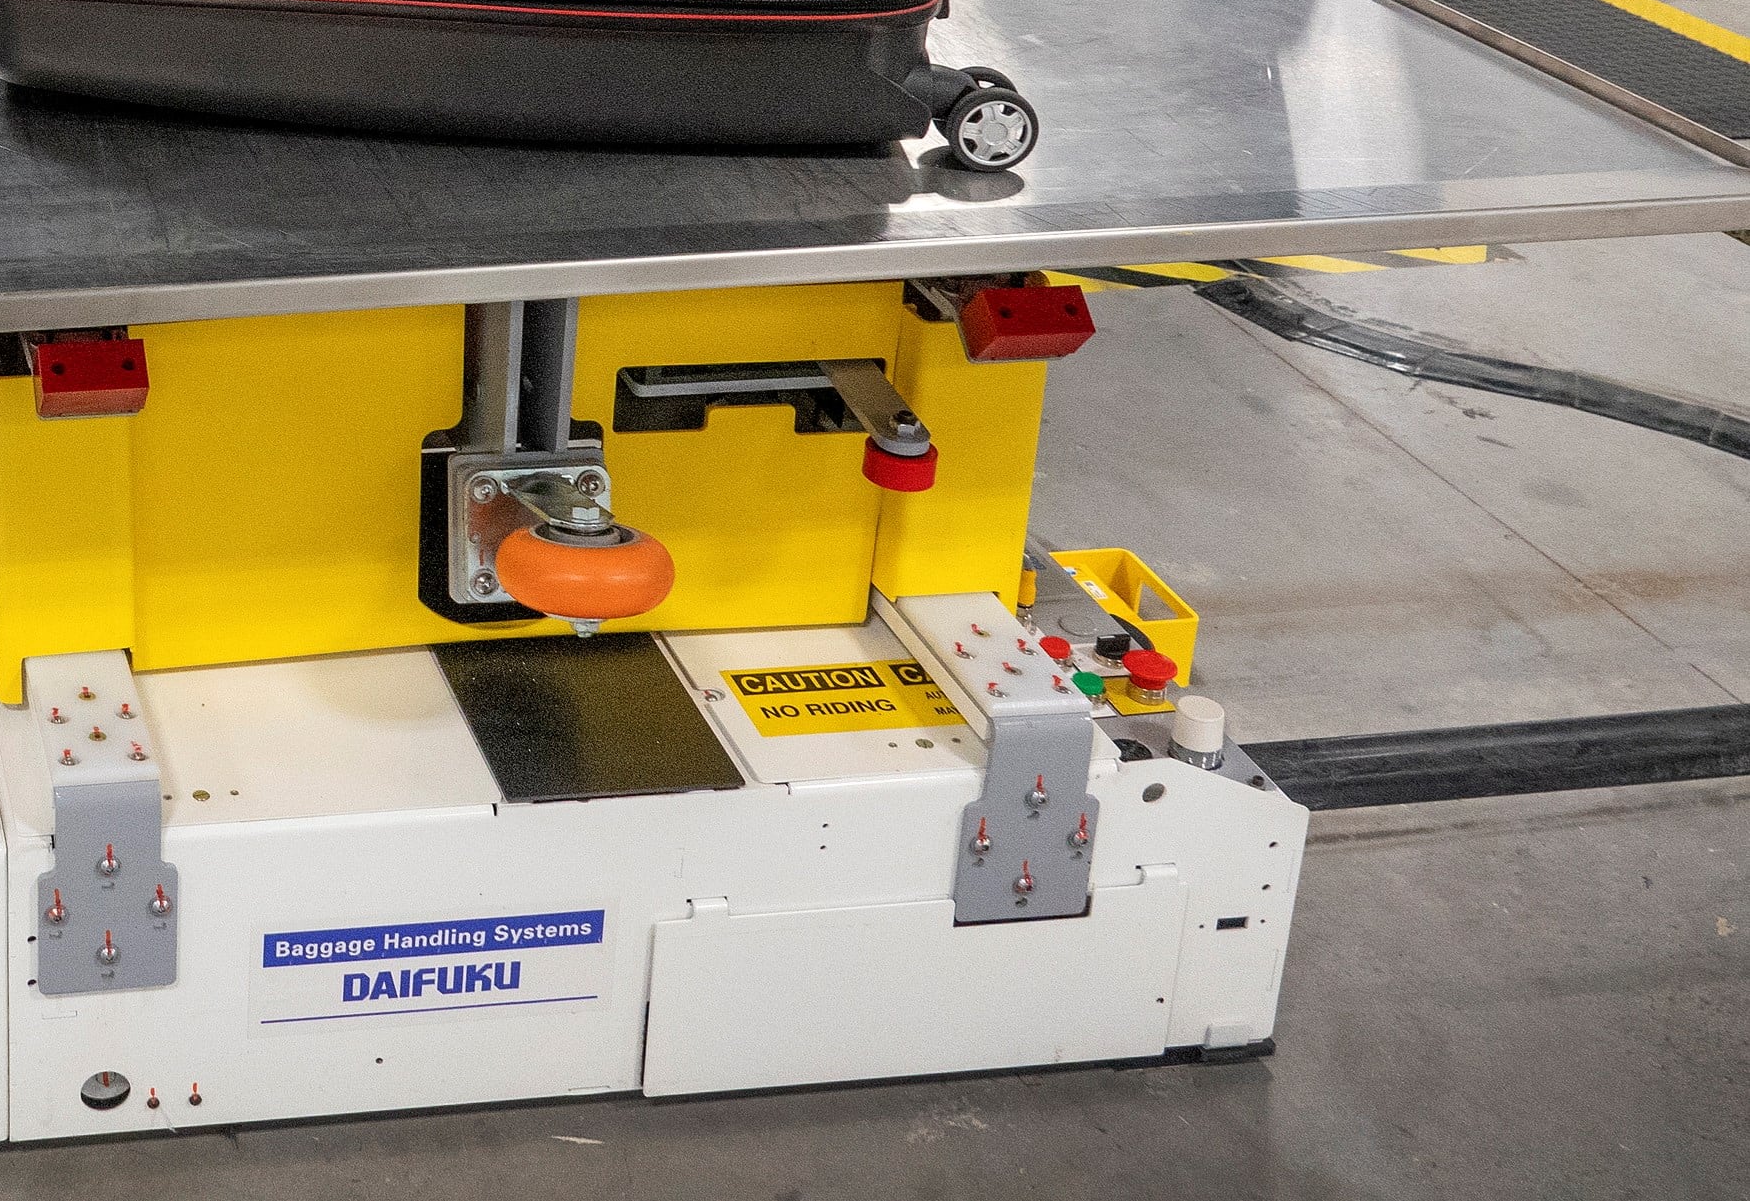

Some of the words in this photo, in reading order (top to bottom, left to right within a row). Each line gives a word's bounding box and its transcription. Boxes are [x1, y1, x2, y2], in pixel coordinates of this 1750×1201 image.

[739, 668, 880, 694] CAUTION
[760, 703, 800, 719] NO
[804, 699, 897, 716] RIDING
[275, 938, 375, 959] Baggage
[383, 927, 486, 950] Handling
[493, 921, 592, 944] Systems
[342, 960, 521, 1002] DAIFUKU
